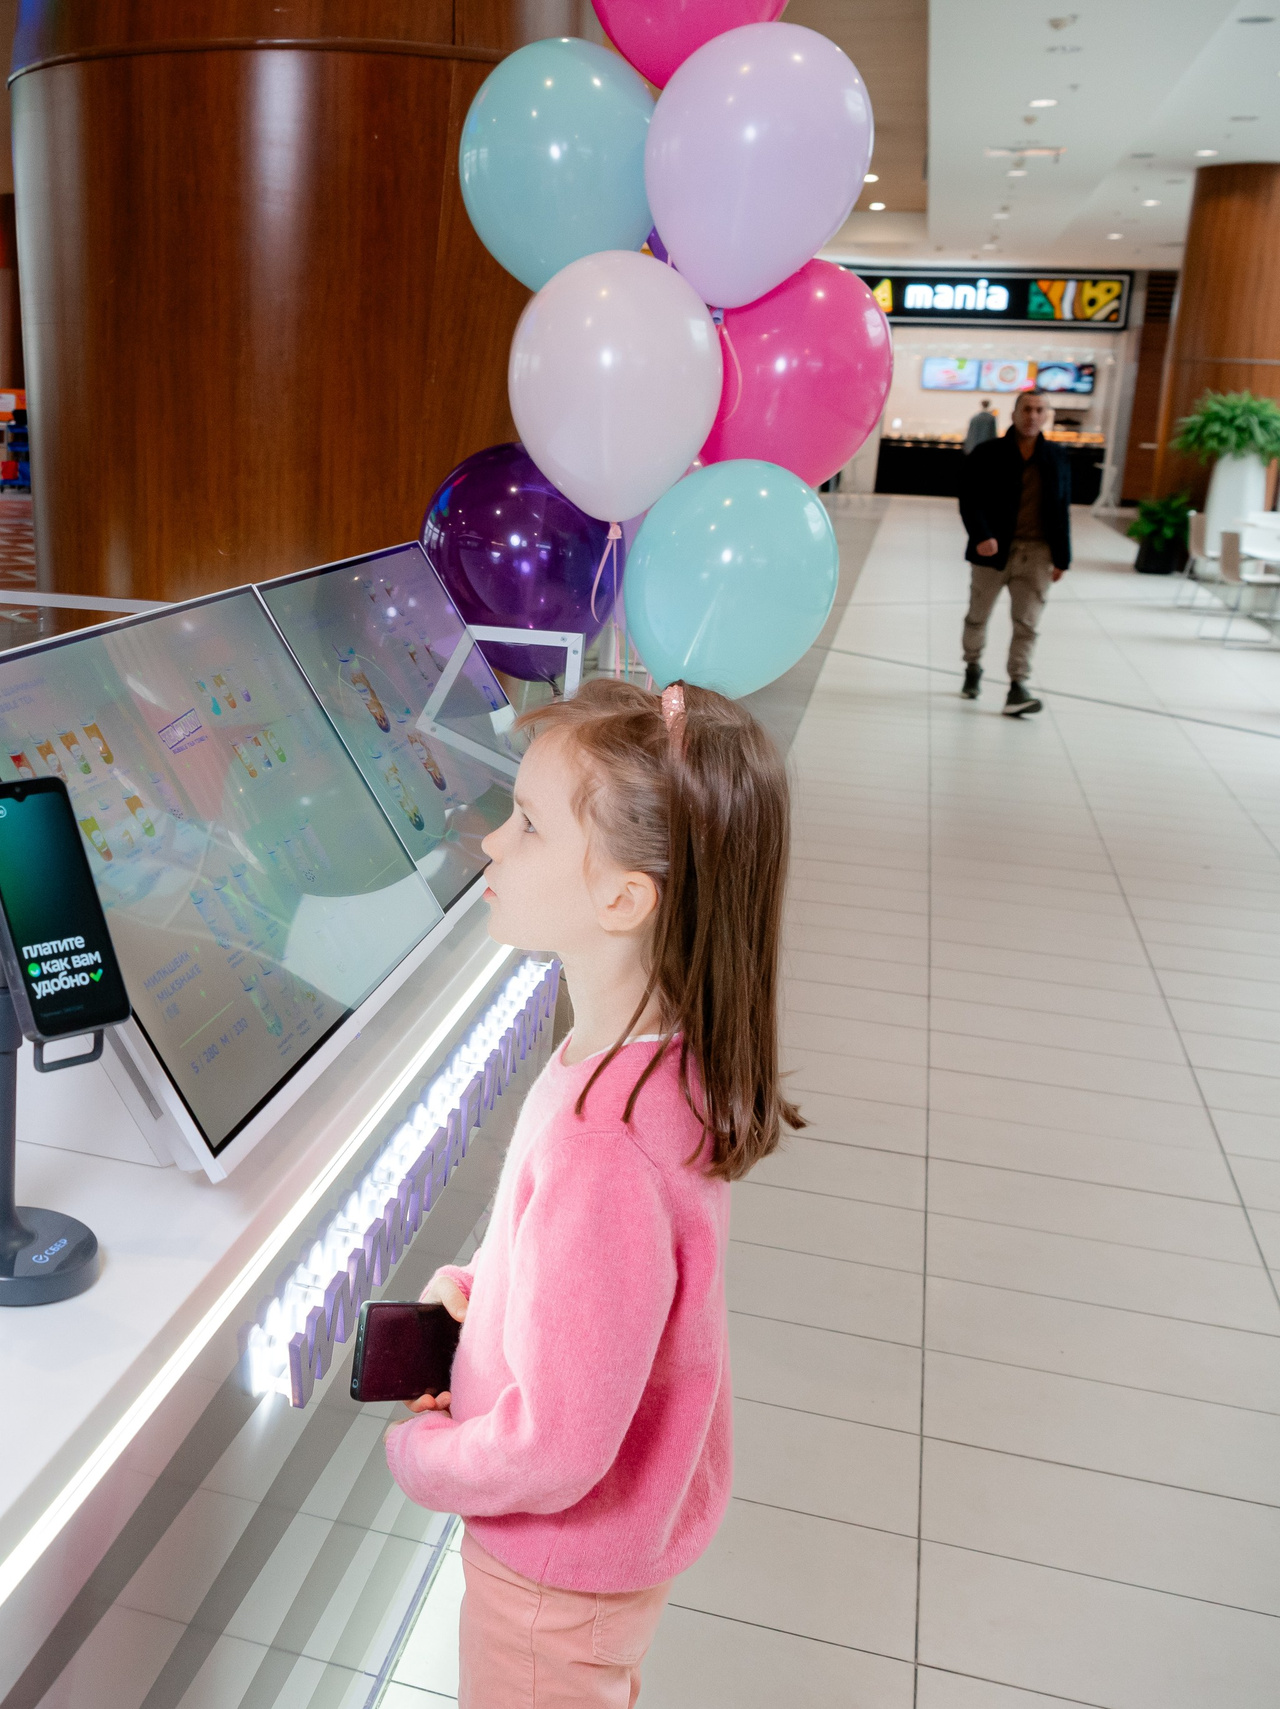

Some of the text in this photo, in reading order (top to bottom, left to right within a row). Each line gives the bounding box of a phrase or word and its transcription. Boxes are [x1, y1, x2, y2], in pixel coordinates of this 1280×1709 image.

[904, 279, 1009, 311] mania
[22, 935, 86, 960] платите
[41, 951, 102, 975] как вам
[143, 950, 192, 991] МИЛКШЕЙК
[31, 972, 90, 1000] удобно
[156, 963, 202, 1002] MILKSHAKE
